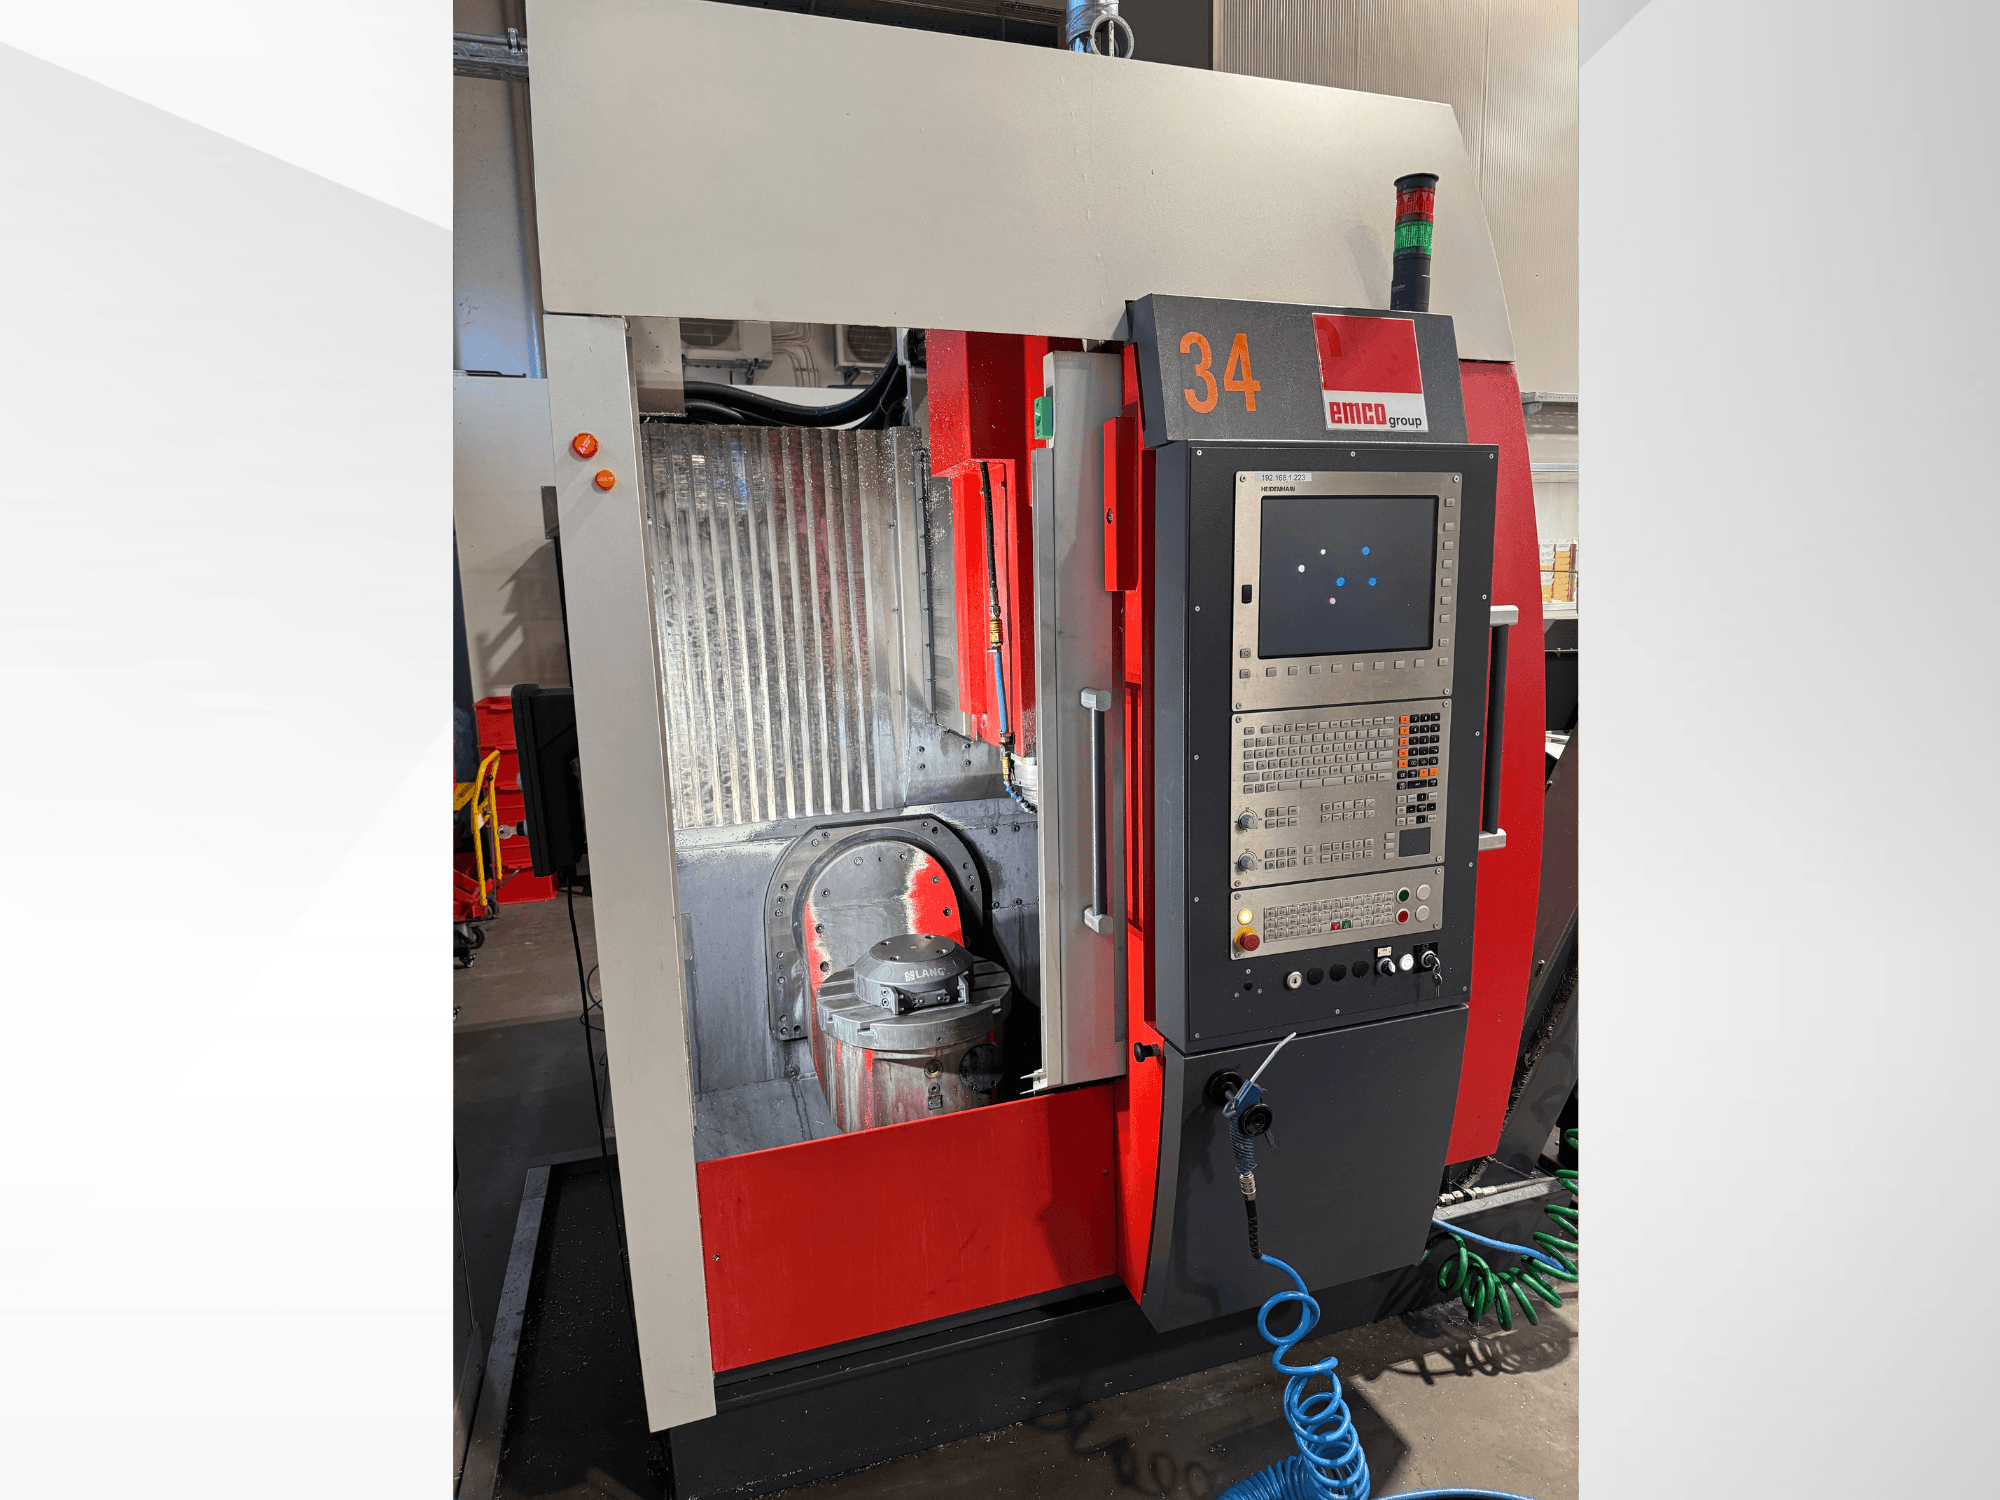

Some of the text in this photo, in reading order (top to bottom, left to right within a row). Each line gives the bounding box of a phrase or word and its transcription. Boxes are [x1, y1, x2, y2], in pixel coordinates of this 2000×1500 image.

[1179, 331, 1261, 414] 34
[1328, 401, 1422, 428] emco group
[915, 968, 944, 979] LANG
